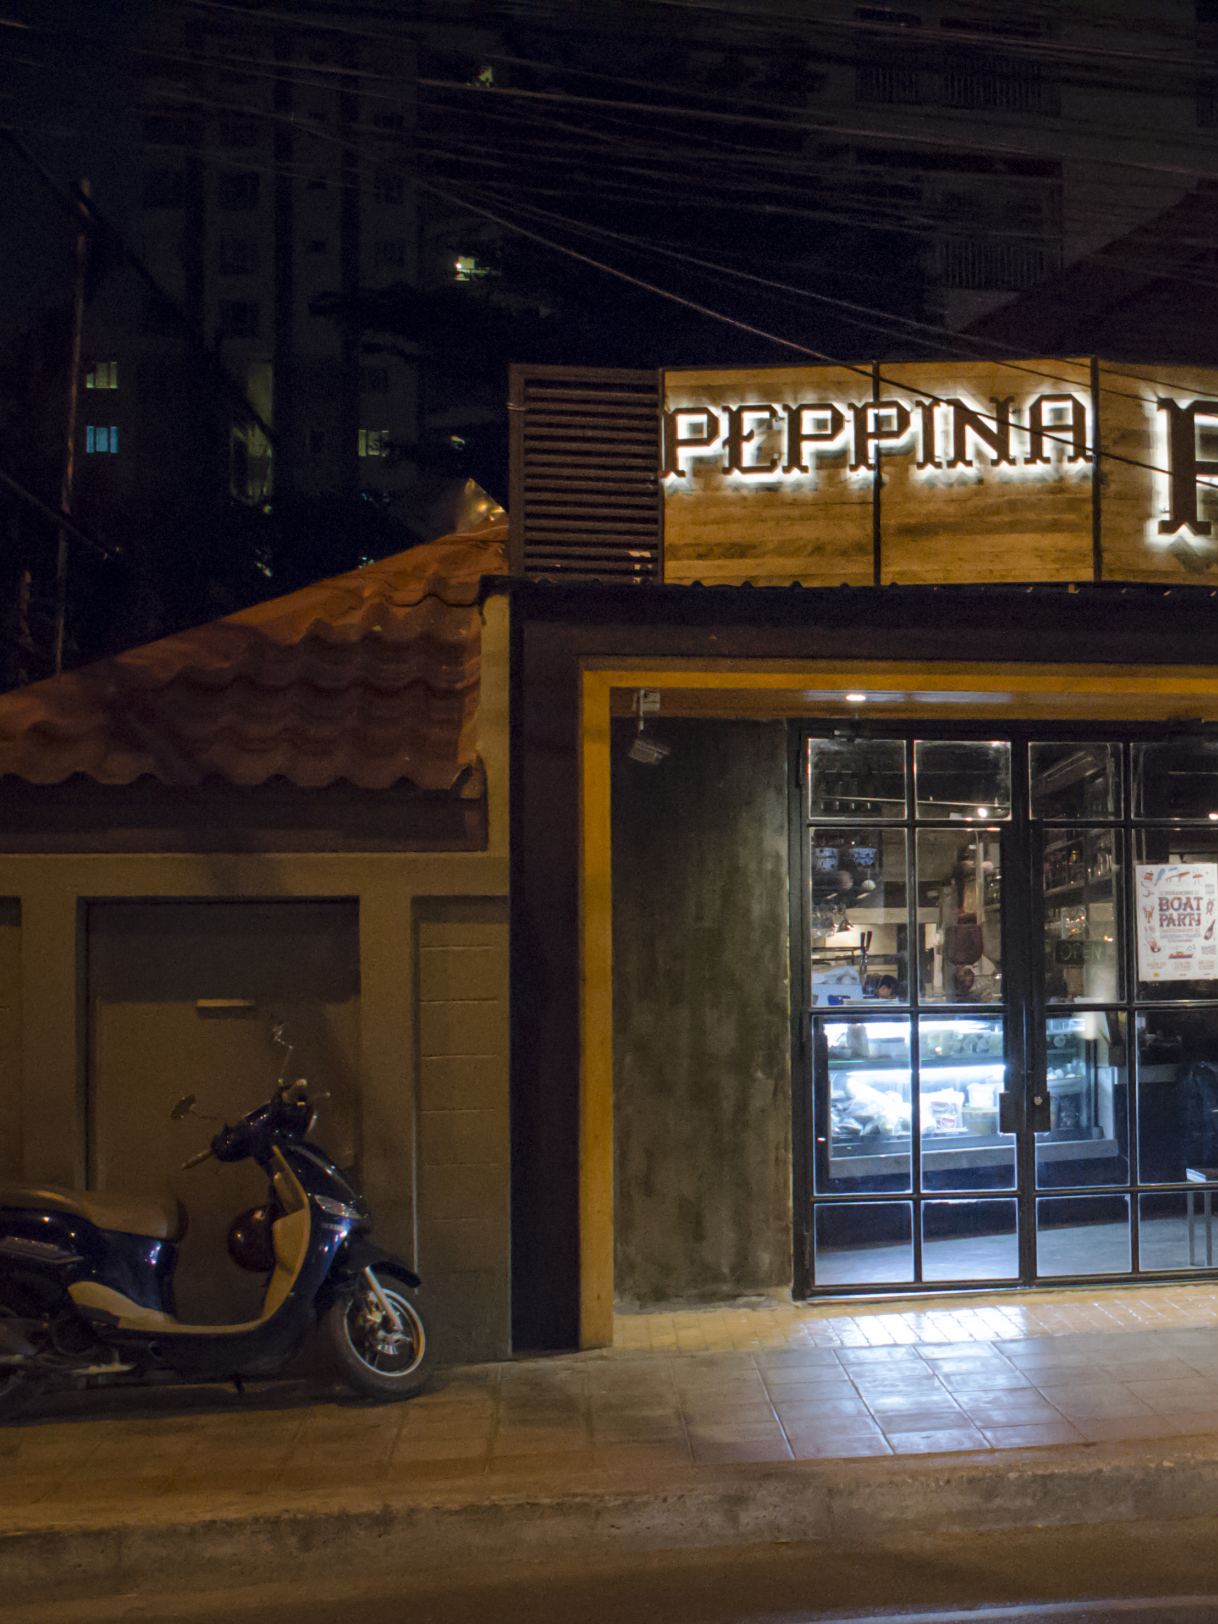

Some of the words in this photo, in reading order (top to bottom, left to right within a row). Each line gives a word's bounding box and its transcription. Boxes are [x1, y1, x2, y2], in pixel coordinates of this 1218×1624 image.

[660, 393, 1094, 479] PEPPINA
[1158, 897, 1204, 913] BOAT
[1158, 913, 1202, 928] PARTY
